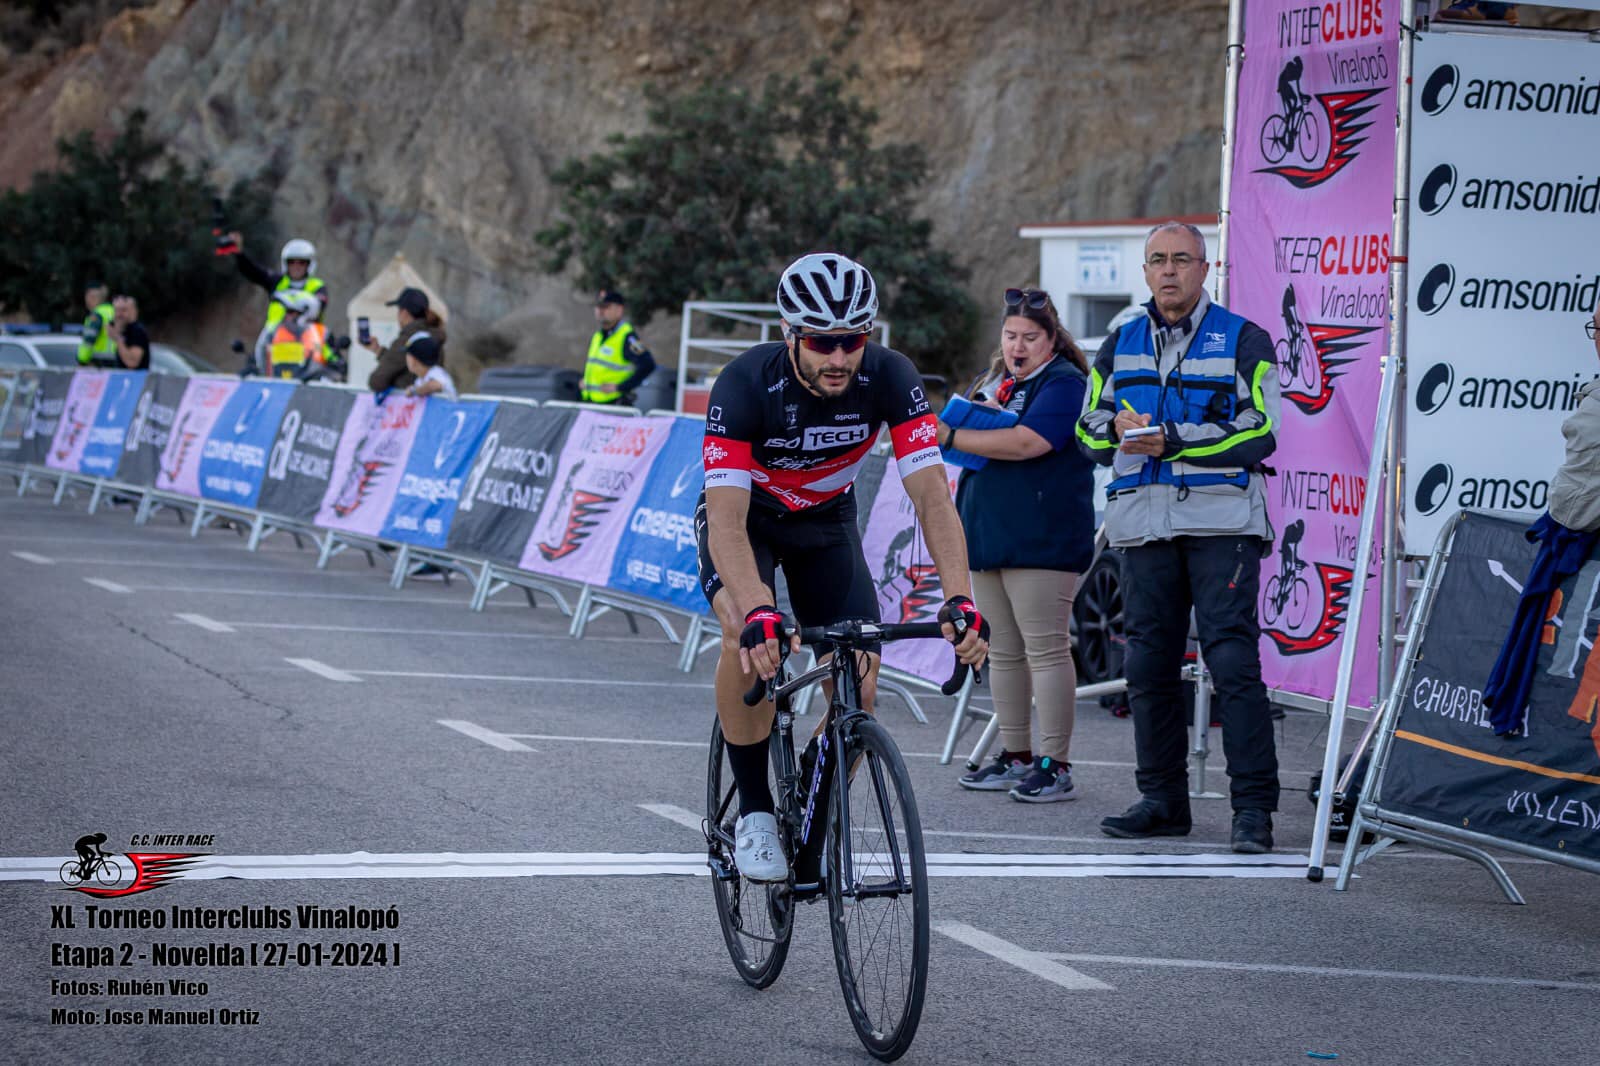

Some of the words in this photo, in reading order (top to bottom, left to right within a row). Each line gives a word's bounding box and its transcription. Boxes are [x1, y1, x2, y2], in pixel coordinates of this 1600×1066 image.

[1327, 46, 1389, 86] Vinalopó
[1462, 175, 1600, 214] amsonid
[1320, 285, 1385, 320] Vinalopó
[1460, 273, 1600, 313] amsonid
[1458, 478, 1549, 510] amso
